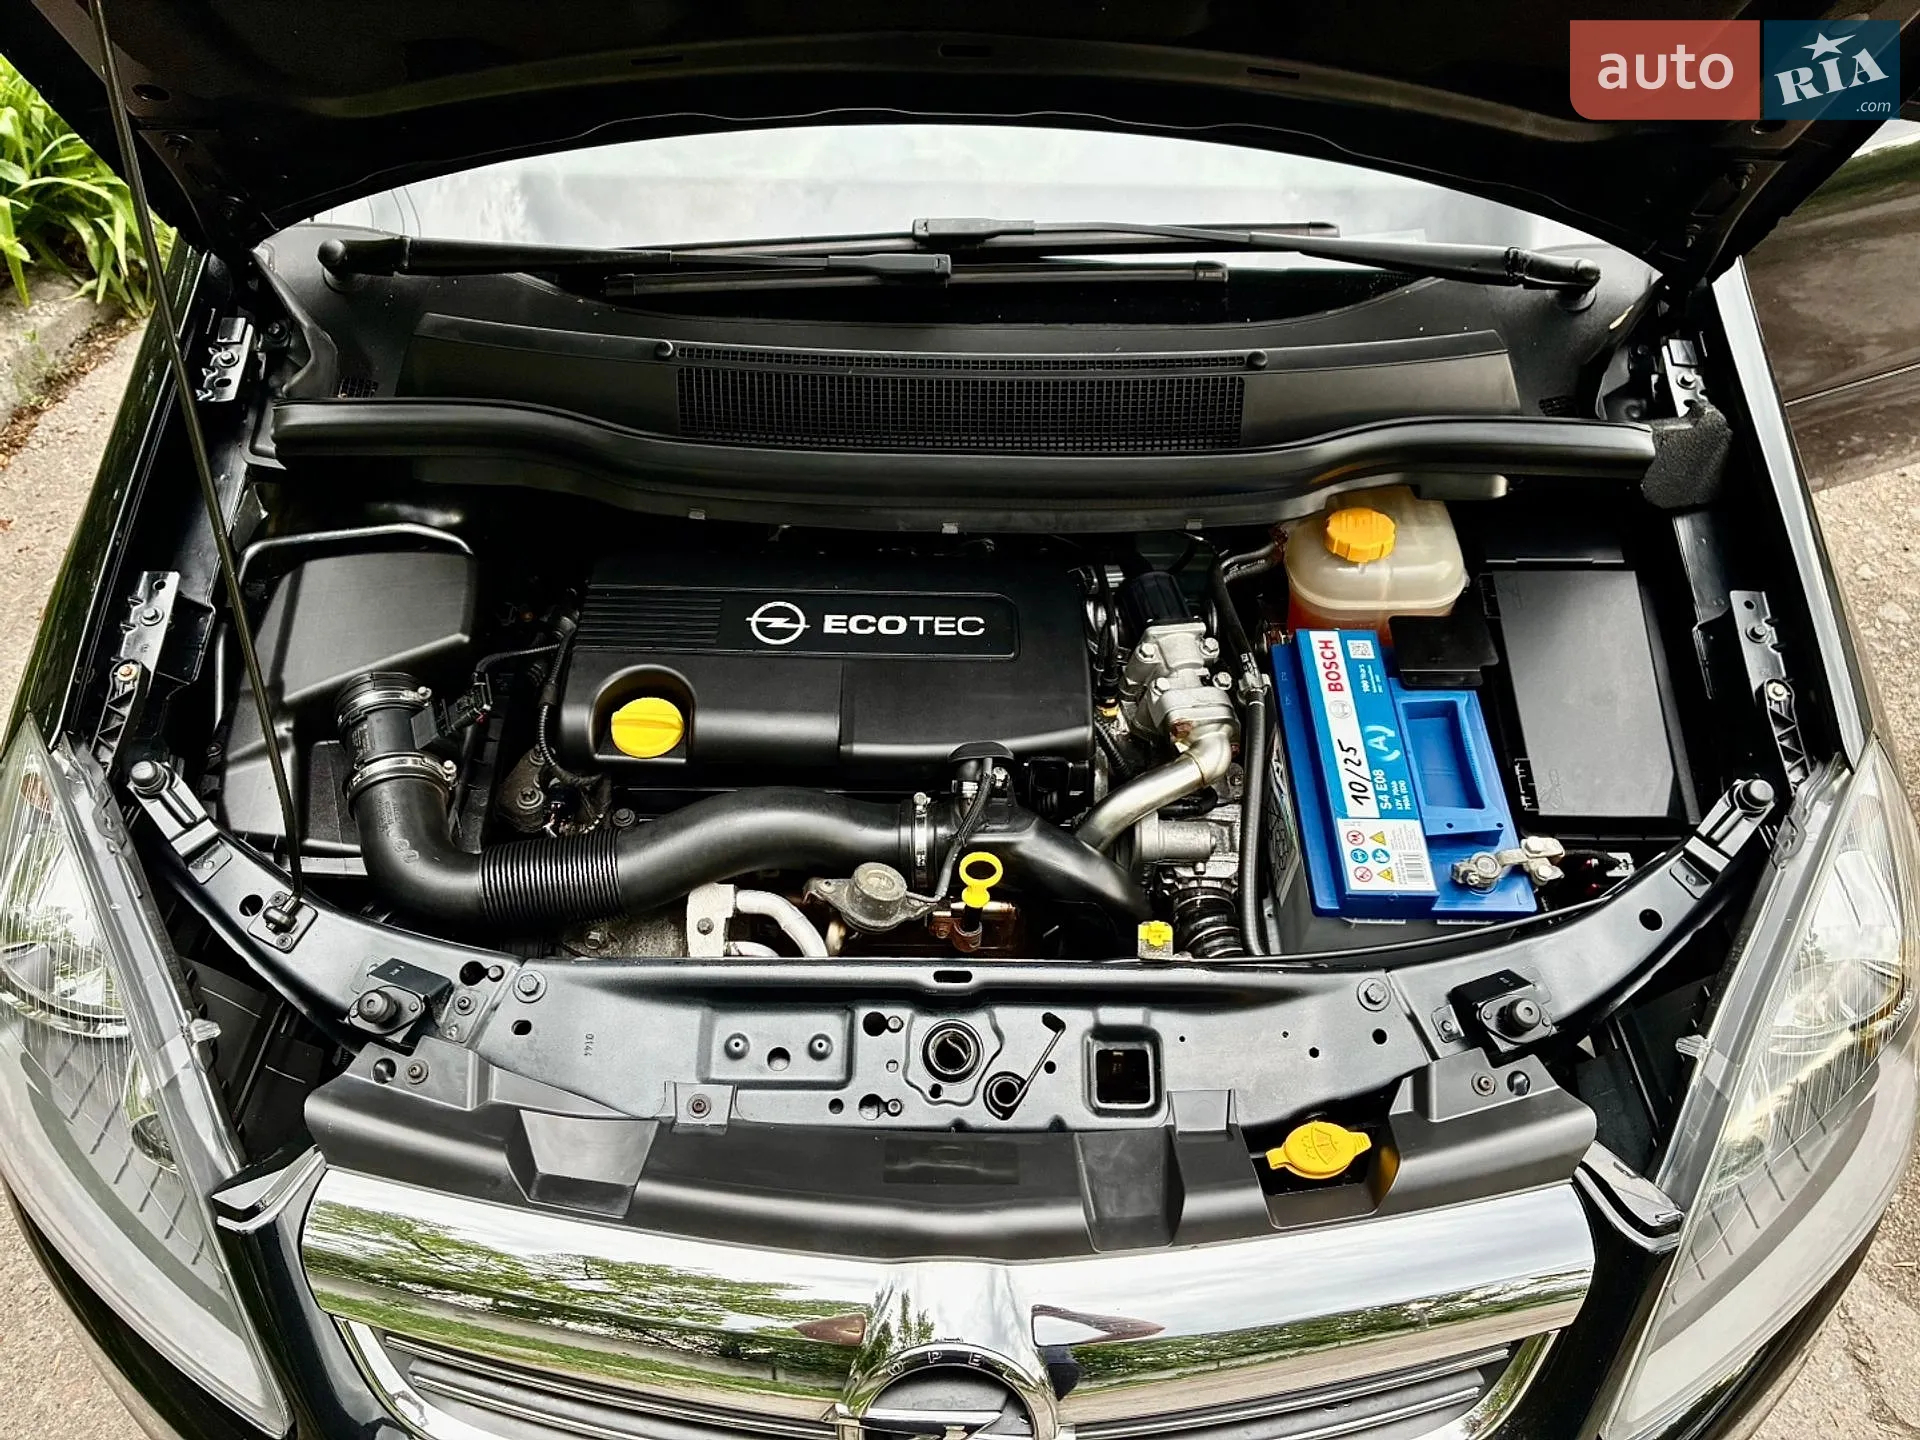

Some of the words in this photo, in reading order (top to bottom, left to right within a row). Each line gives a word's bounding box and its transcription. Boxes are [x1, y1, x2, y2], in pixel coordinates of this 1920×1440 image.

[823, 614, 985, 636] ECOTEC
[1318, 640, 1344, 692] BOSCH
[1337, 738, 1372, 806] 10/25
[1372, 769, 1388, 791] E08
[1378, 795, 1392, 810] S4
[887, 1351, 1015, 1382] OPEL
